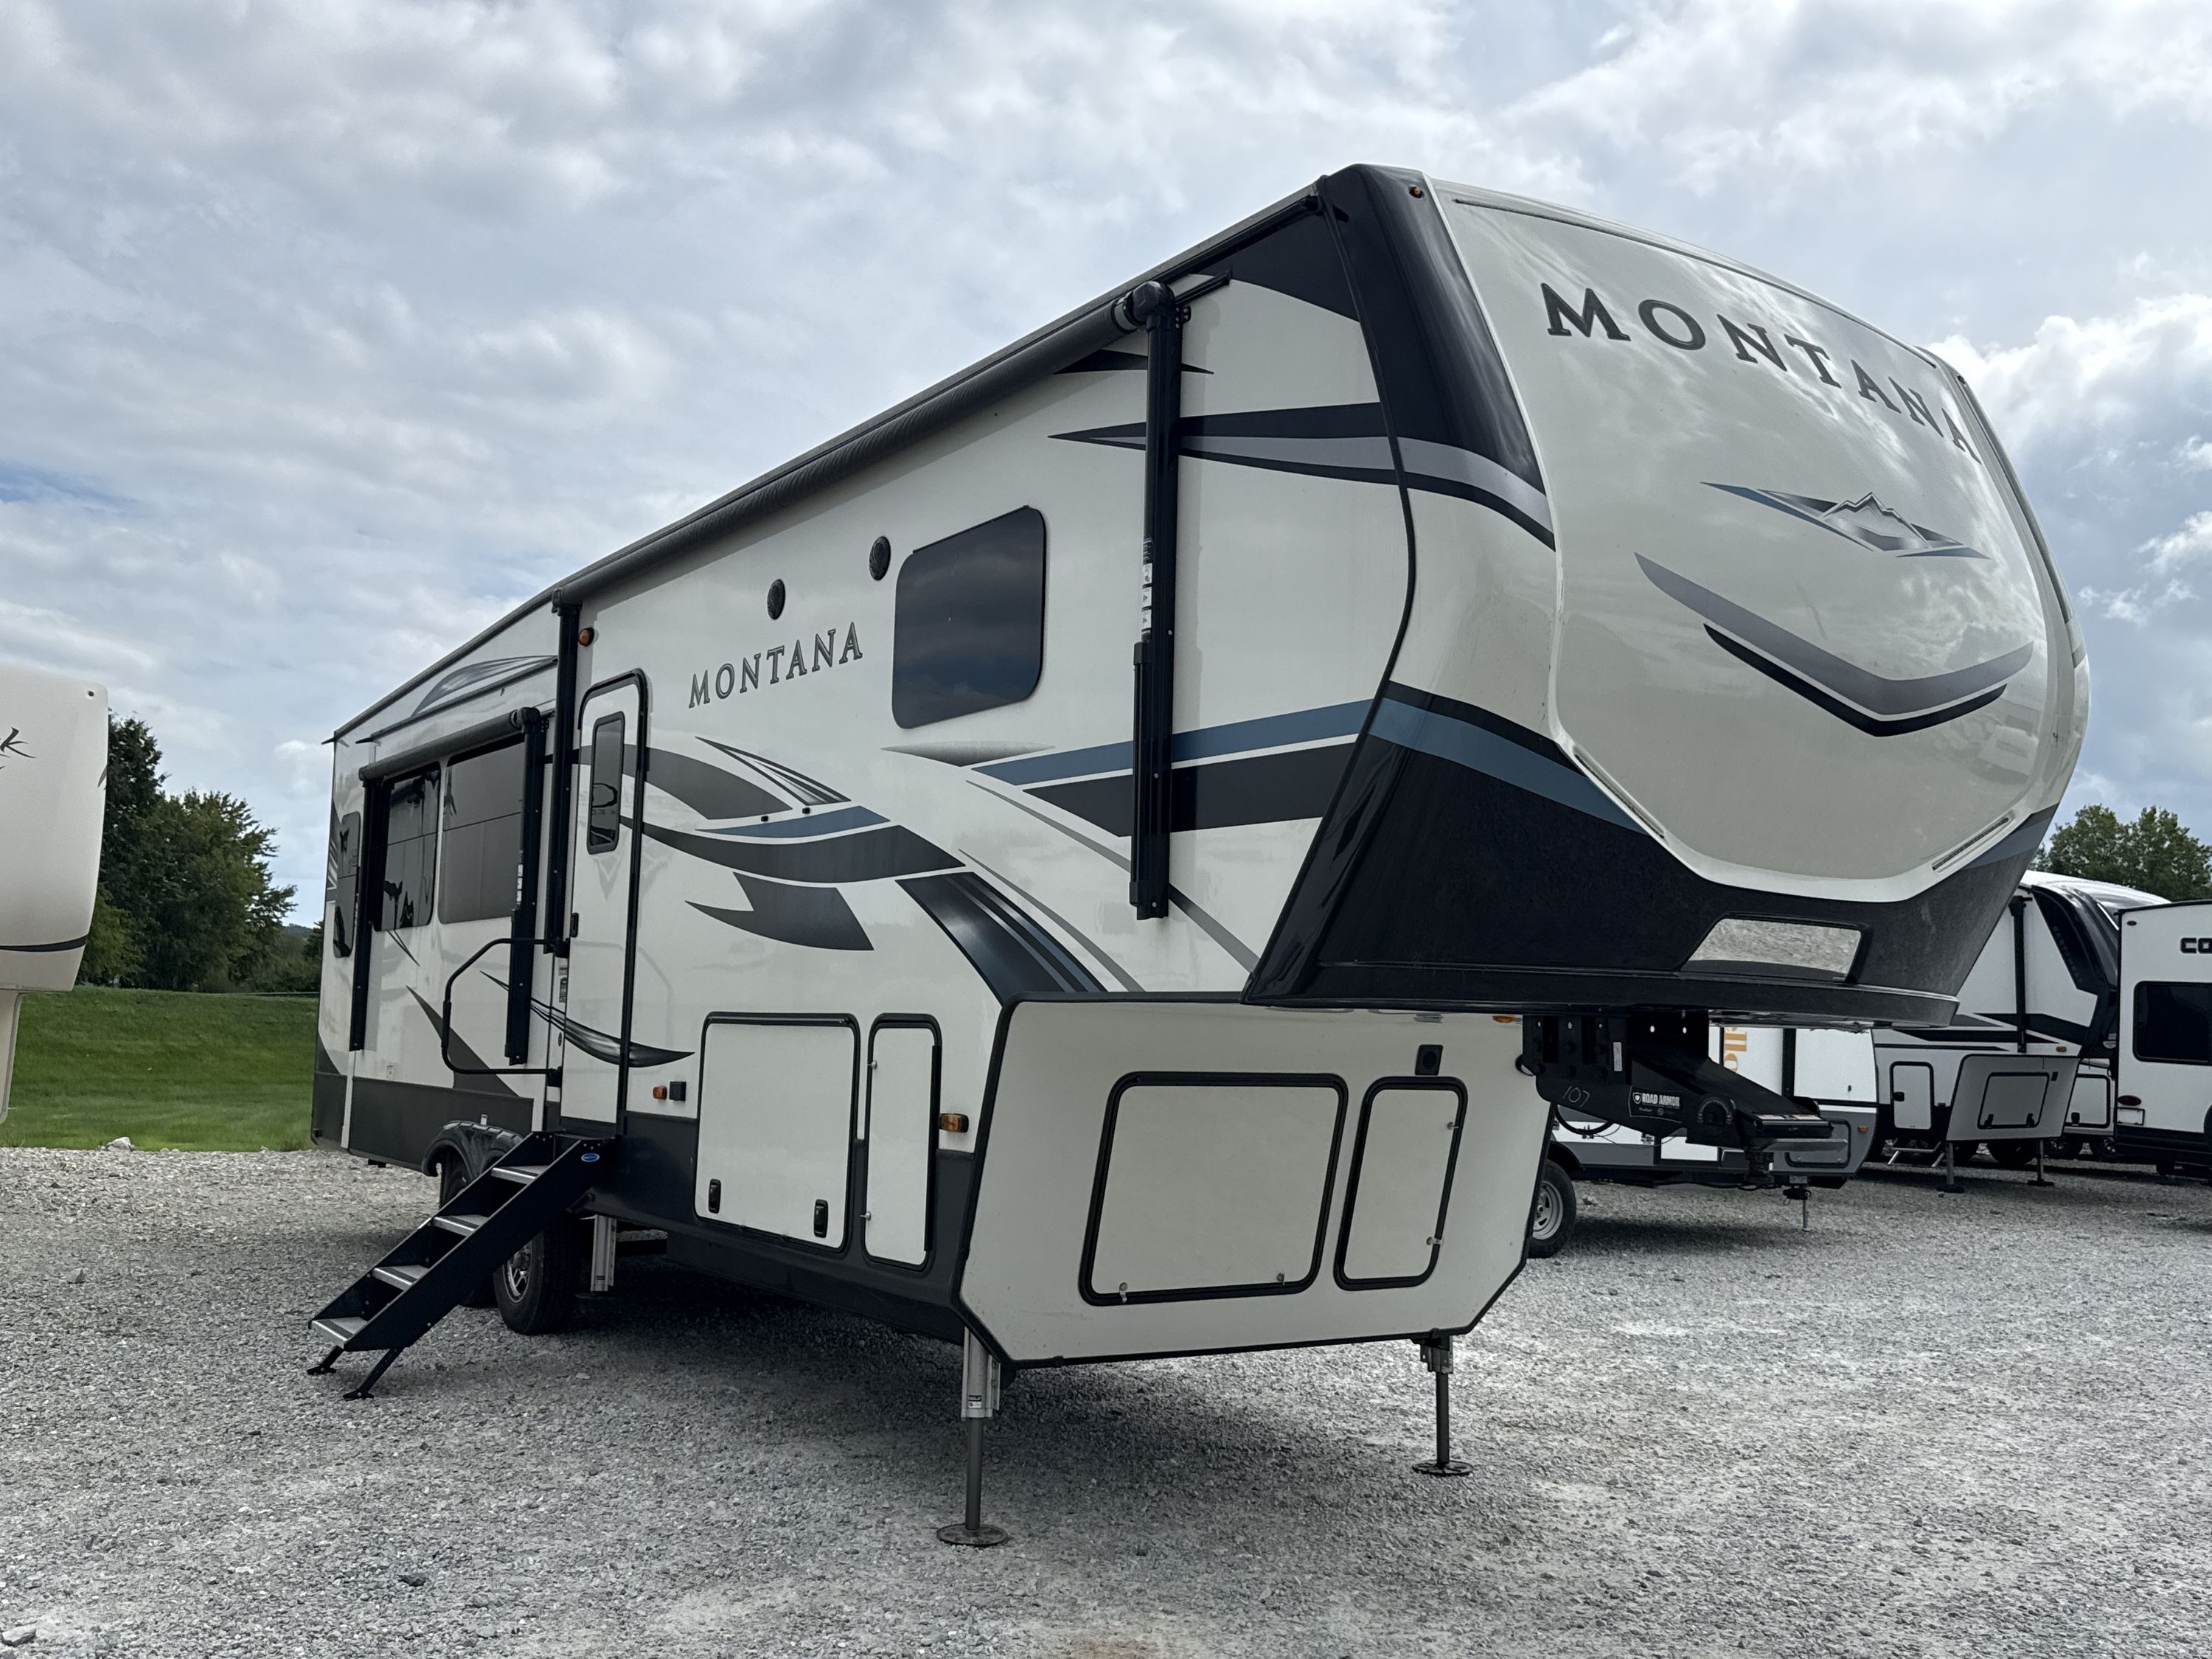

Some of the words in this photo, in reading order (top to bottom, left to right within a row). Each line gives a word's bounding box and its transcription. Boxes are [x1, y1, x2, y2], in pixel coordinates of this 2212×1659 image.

[1540, 282, 1982, 465] MONTANA
[689, 622, 863, 709] MONTANA
[1642, 1093, 1658, 1105] ROAD
[1659, 1095, 1680, 1107] ARMOR
